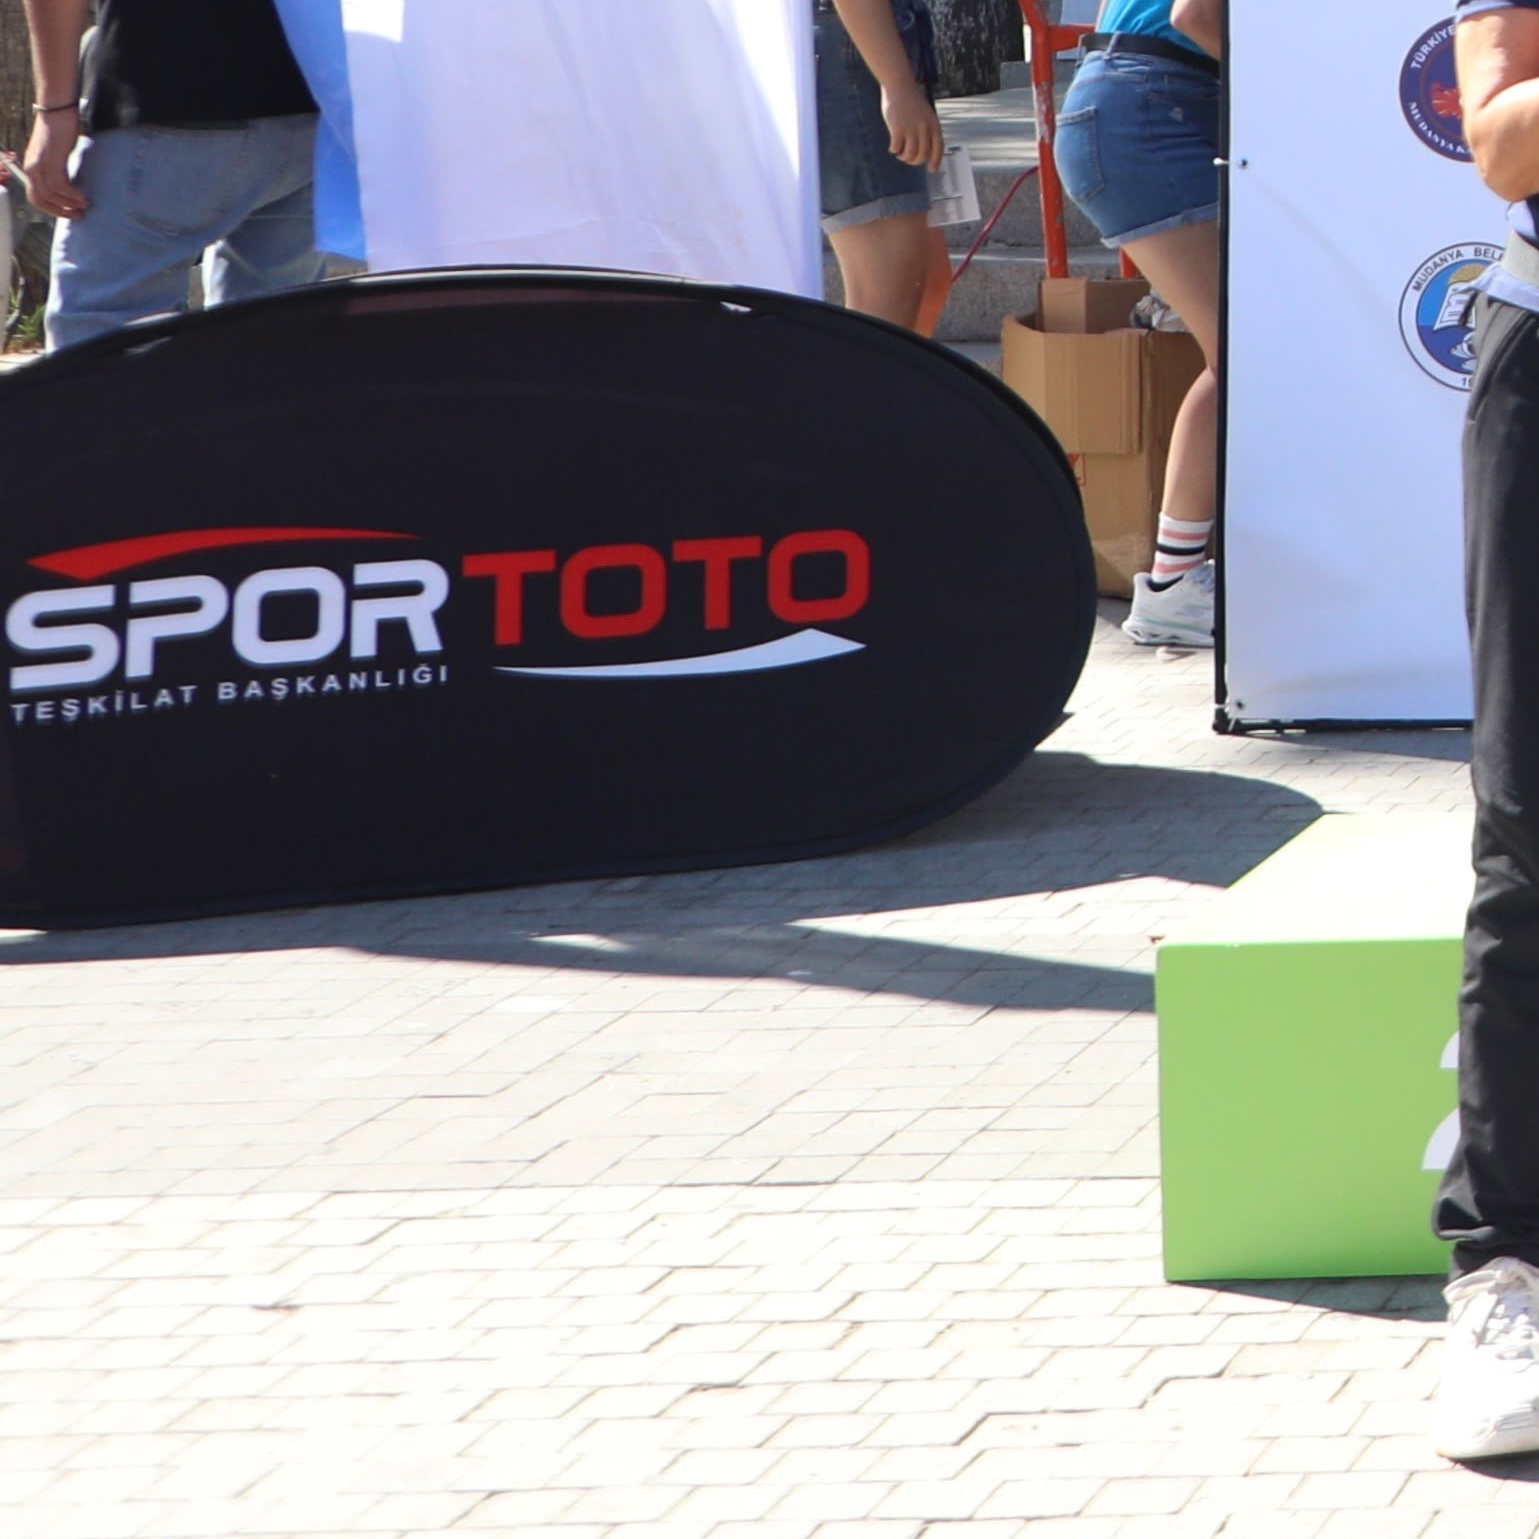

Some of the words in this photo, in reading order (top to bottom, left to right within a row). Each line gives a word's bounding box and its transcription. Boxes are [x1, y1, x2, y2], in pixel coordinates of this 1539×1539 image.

[1412, 249, 1464, 293] MUDANYA
[11, 685, 196, 724] TEŞKİLAT
[219, 662, 450, 705] BAŞKANLIĞI
